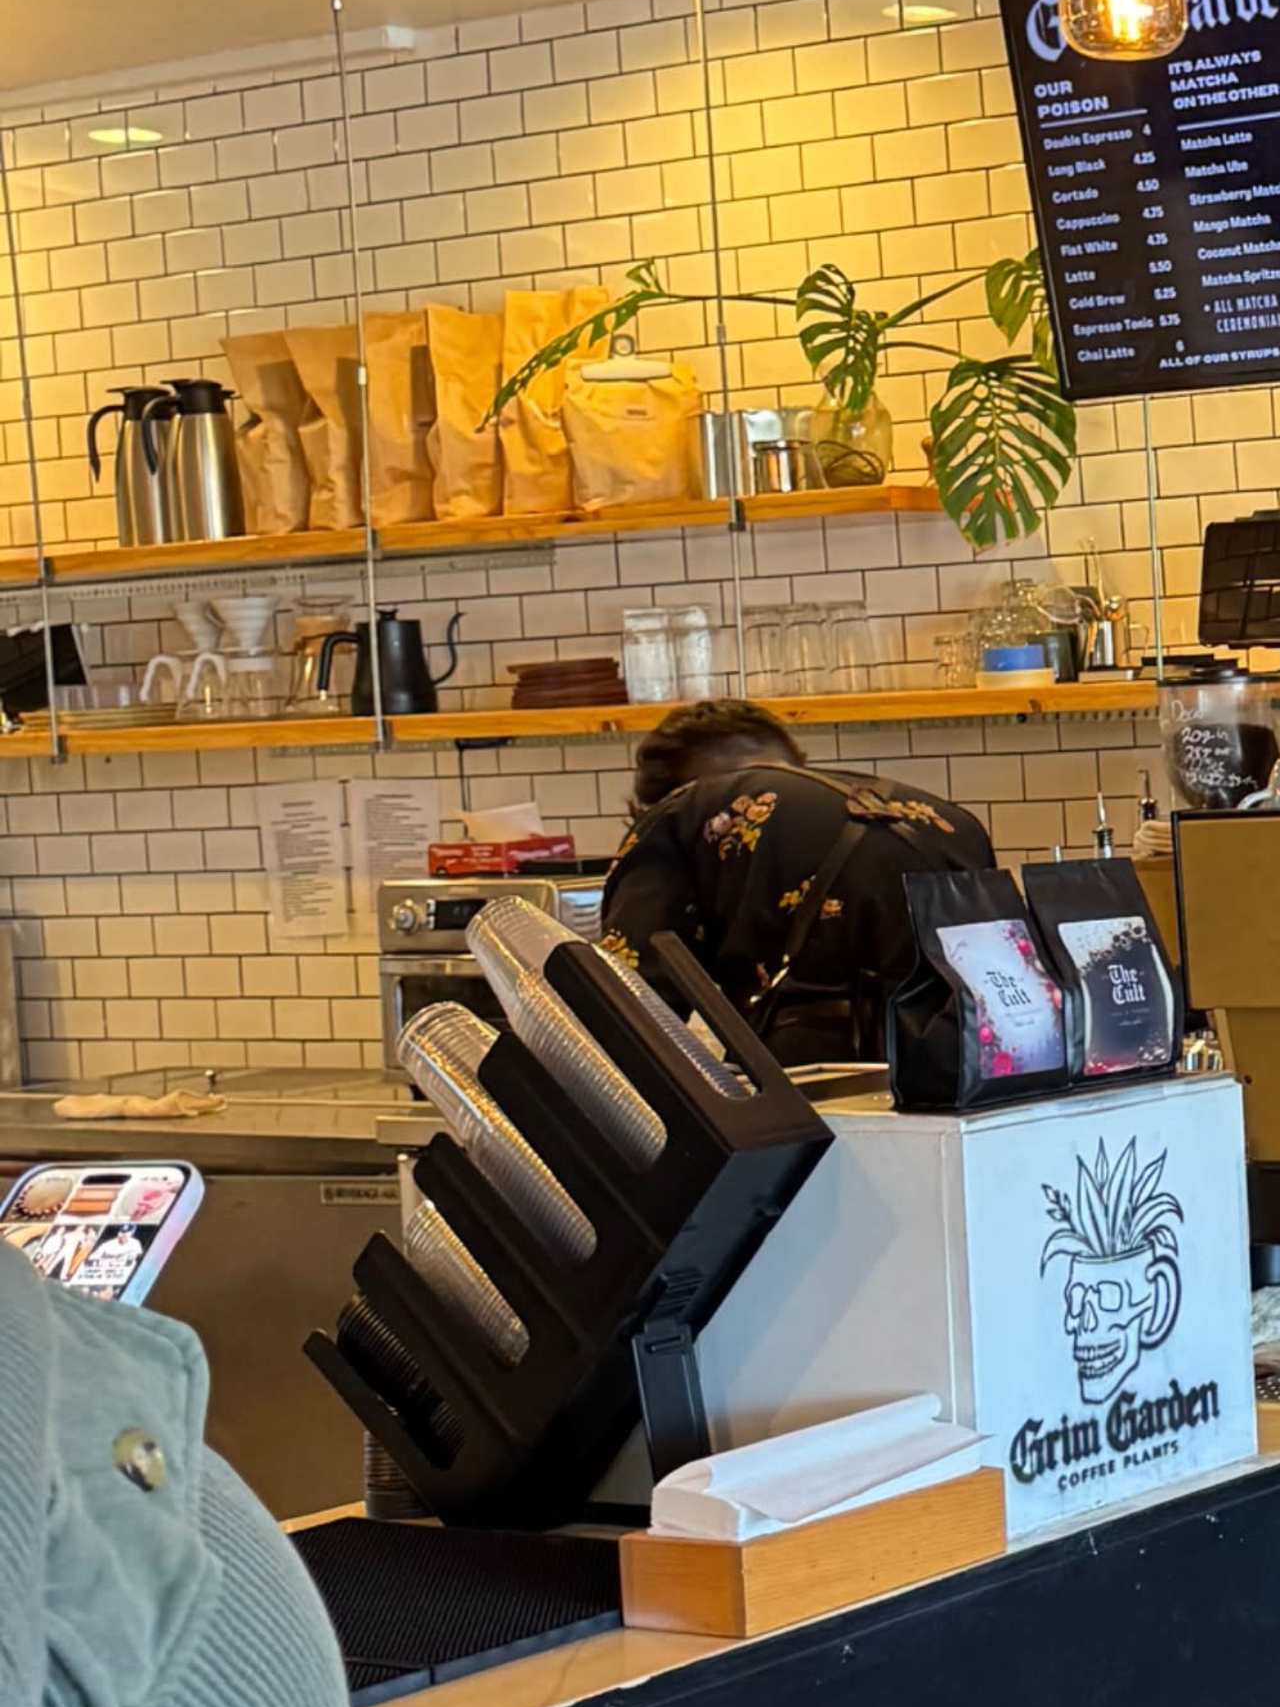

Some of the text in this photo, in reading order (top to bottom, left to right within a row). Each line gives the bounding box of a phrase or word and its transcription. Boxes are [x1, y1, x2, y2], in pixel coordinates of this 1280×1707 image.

[1194, 50, 1262, 71] ALWAYS
[1034, 80, 1072, 98] OUR
[1170, 72, 1238, 92] MATCHA
[1173, 97, 1196, 110] ON
[1197, 91, 1228, 106] THE
[1229, 84, 1280, 101] OTHER
[1037, 96, 1109, 119] POISON
[1043, 123, 1152, 150] Double Espresso 4
[1180, 136, 1221, 151] Matcha
[1222, 131, 1253, 145] Latte
[1047, 165, 1074, 177] Long
[1184, 163, 1226, 178] Matcha
[1052, 187, 1099, 204] Cortado
[1189, 189, 1252, 206] Strawberry
[1193, 219, 1229, 233] Mango
[1229, 213, 1272, 229] Matcha
[1060, 244, 1083, 257] Flat
[1084, 241, 1119, 254] White
[1197, 245, 1242, 261] Coconut
[1065, 271, 1096, 284] Latte
[1201, 272, 1242, 287] Matcha
[1069, 297, 1094, 310] Cold
[1095, 294, 1126, 307] Brew
[1213, 299, 1233, 314] ALL
[1236, 295, 1278, 311] MATCHA
[1073, 322, 1123, 337] Espresso
[1077, 349, 1103, 362] Chai
[1104, 346, 1135, 359] Latte
[1159, 357, 1183, 369] ALL
[1184, 354, 1201, 366] OF
[1203, 352, 1230, 364] OUR
[1230, 347, 1280, 361] SYRUPS
[986, 970, 1017, 989] The
[1107, 964, 1139, 985] The
[997, 987, 1033, 1008] Cult
[1111, 983, 1147, 1006] Cult
[1009, 1378, 1221, 1484] Grim Garden
[1056, 1439, 1180, 1492] COFFEE PLANTS
